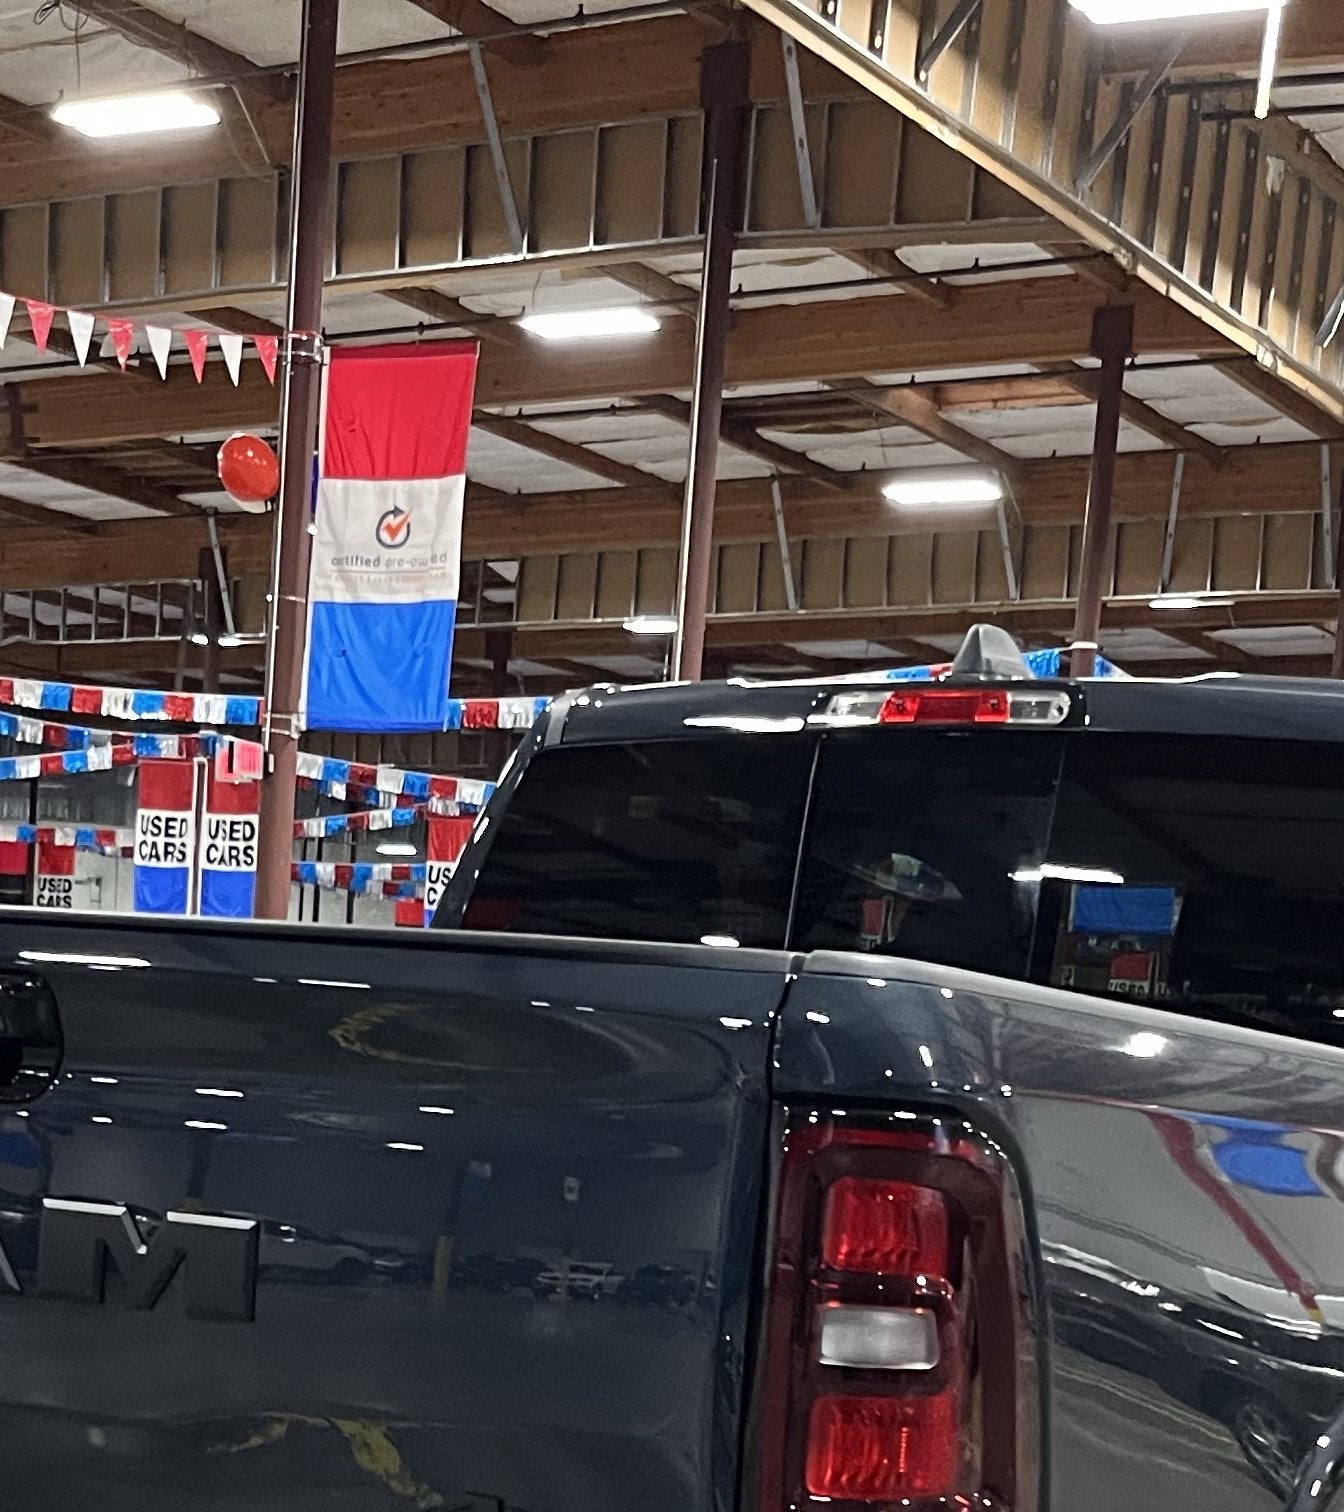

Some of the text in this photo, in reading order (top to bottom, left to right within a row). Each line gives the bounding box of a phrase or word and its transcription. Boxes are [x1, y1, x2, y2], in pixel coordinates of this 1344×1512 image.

[141, 815, 188, 838] USED
[208, 818, 256, 843] USED
[138, 840, 187, 863] CARS
[206, 843, 255, 867] CARS
